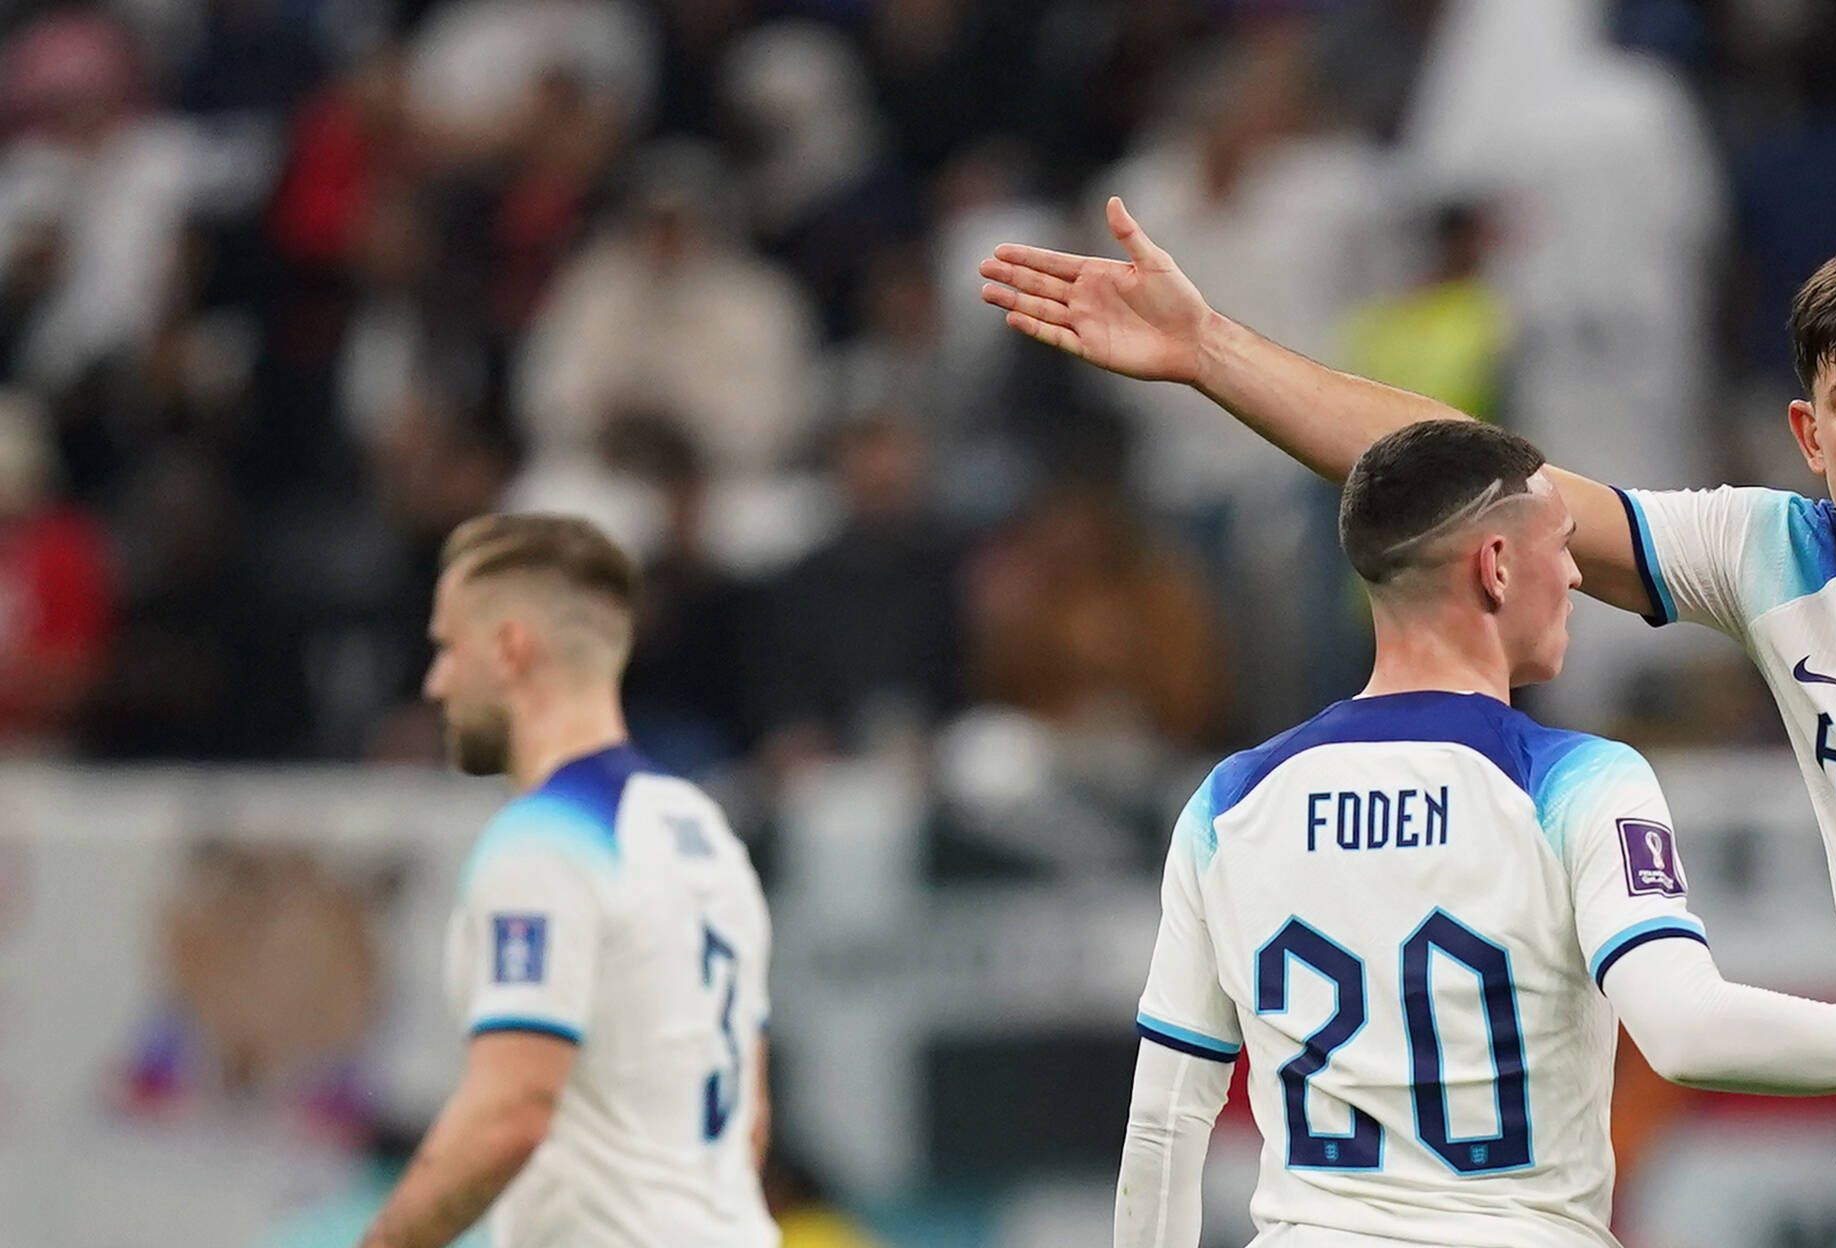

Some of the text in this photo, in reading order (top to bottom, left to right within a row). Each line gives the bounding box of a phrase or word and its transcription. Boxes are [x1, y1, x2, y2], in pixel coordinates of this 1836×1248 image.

[1307, 786, 1448, 851] FODEN
[701, 923, 741, 1142] 3
[1254, 906, 1535, 1176] 20
